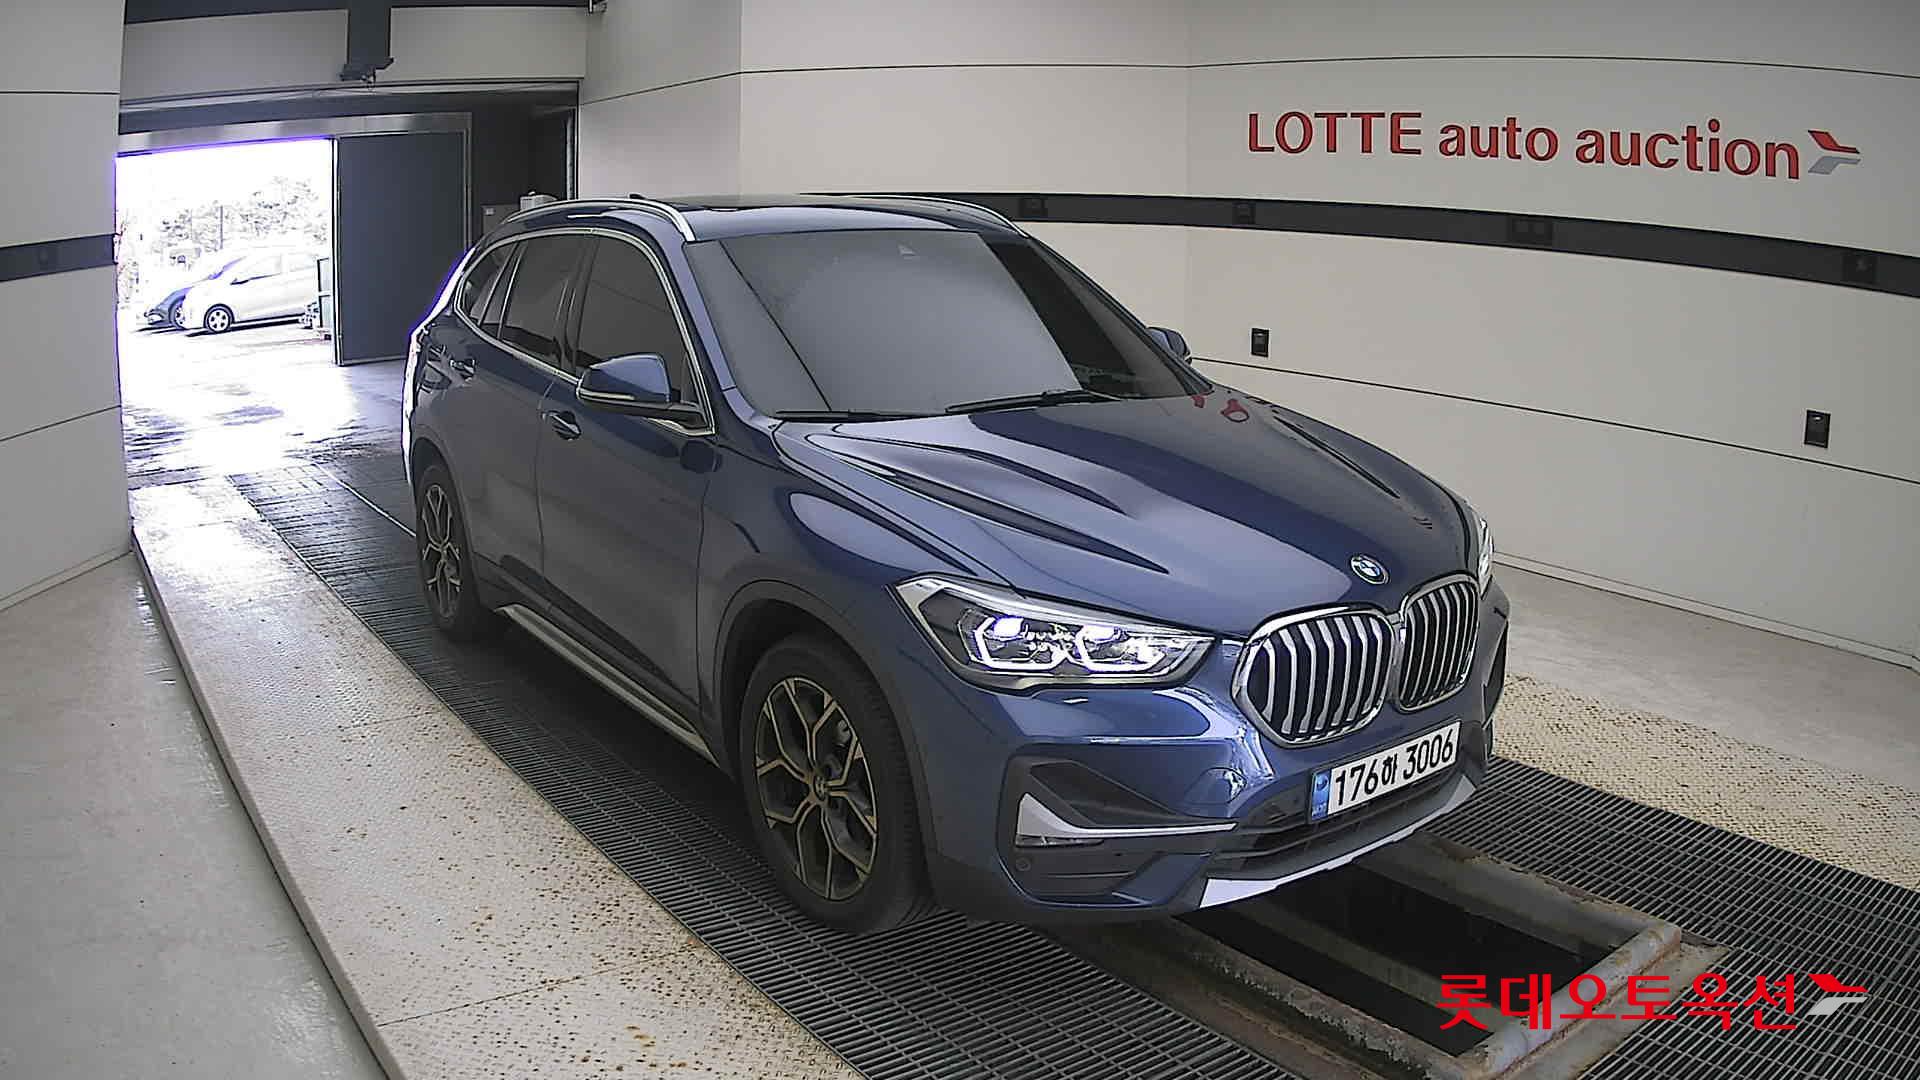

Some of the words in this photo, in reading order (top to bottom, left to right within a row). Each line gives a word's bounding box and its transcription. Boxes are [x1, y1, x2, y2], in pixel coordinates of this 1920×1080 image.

[1248, 111, 1422, 155] LOTTE
[1439, 117, 1559, 161] auto
[1576, 119, 1801, 180] auction
[1335, 753, 1398, 806] 176하
[1403, 729, 1453, 780] 3006
